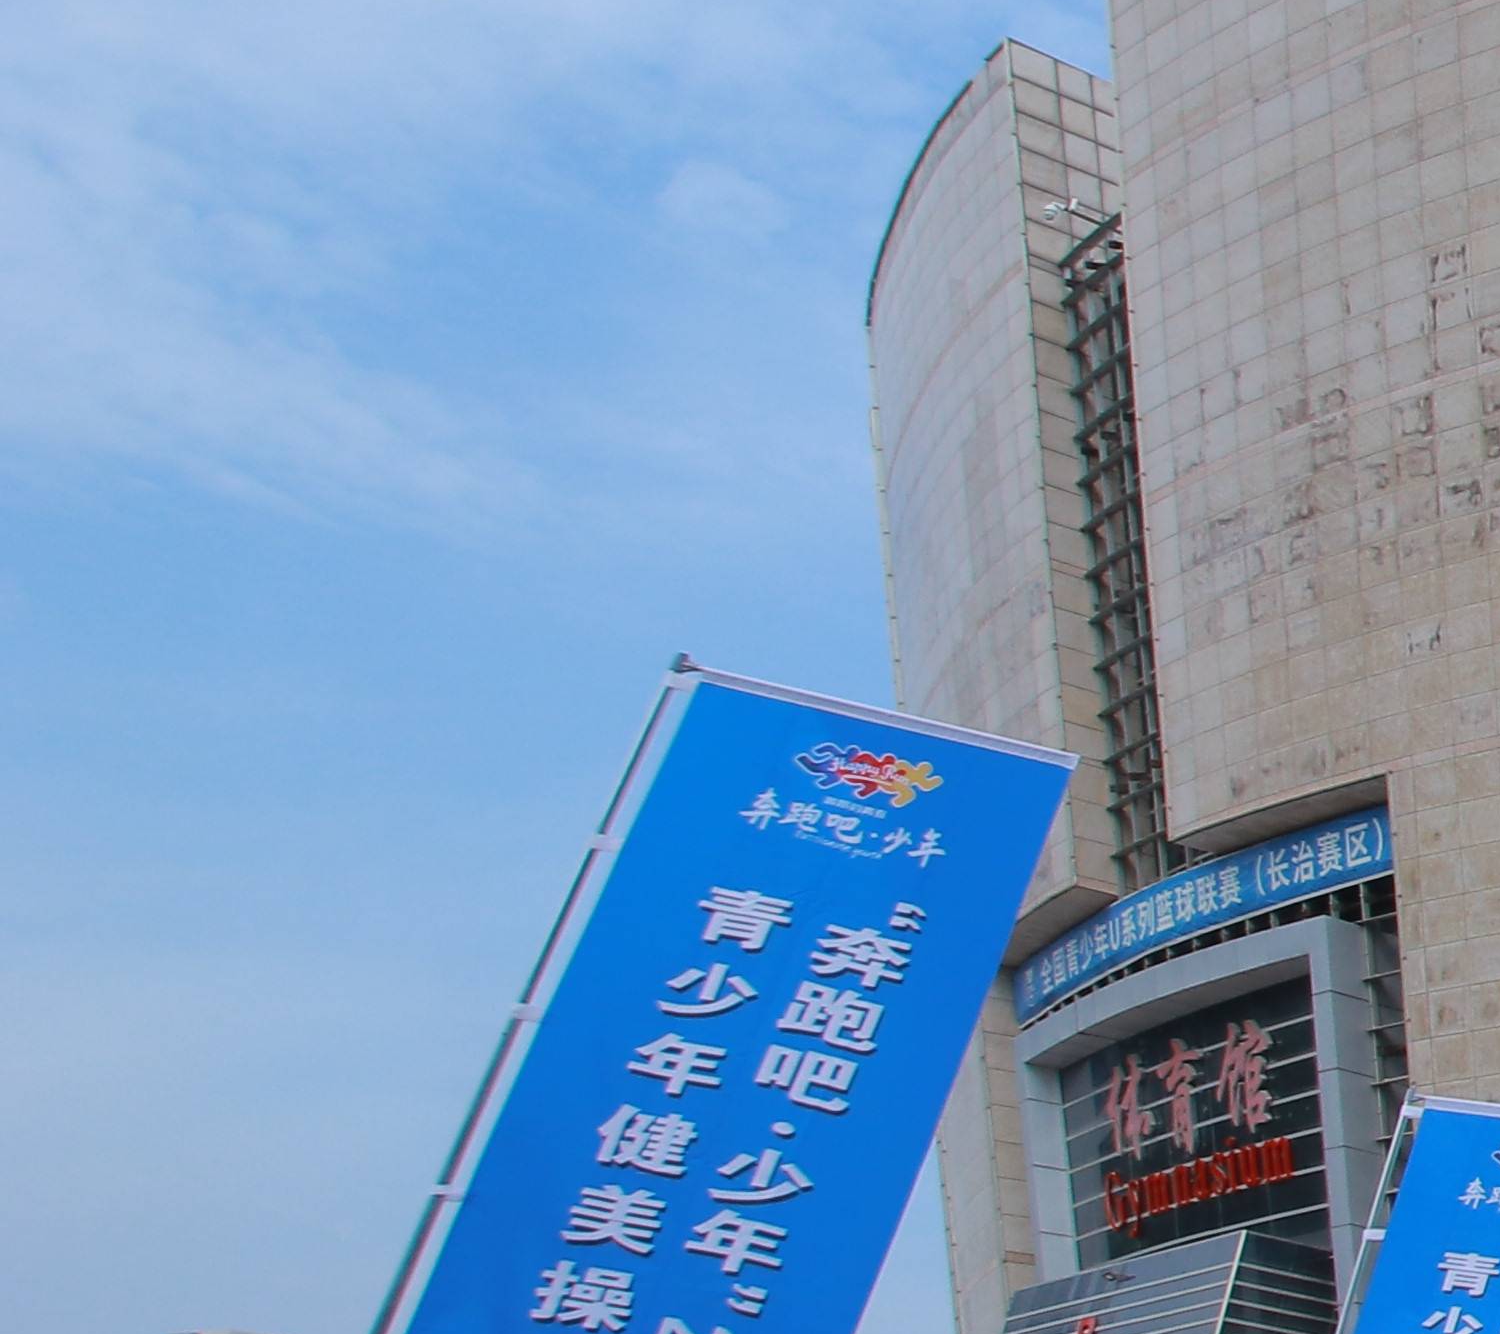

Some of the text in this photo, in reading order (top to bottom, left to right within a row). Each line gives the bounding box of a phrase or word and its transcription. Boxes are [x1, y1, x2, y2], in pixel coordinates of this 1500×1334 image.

[739, 788, 946, 868] 奔跑吧·少年
[1104, 1020, 1274, 1160] 体育馆
[1104, 1136, 1296, 1239] Gymnasium
